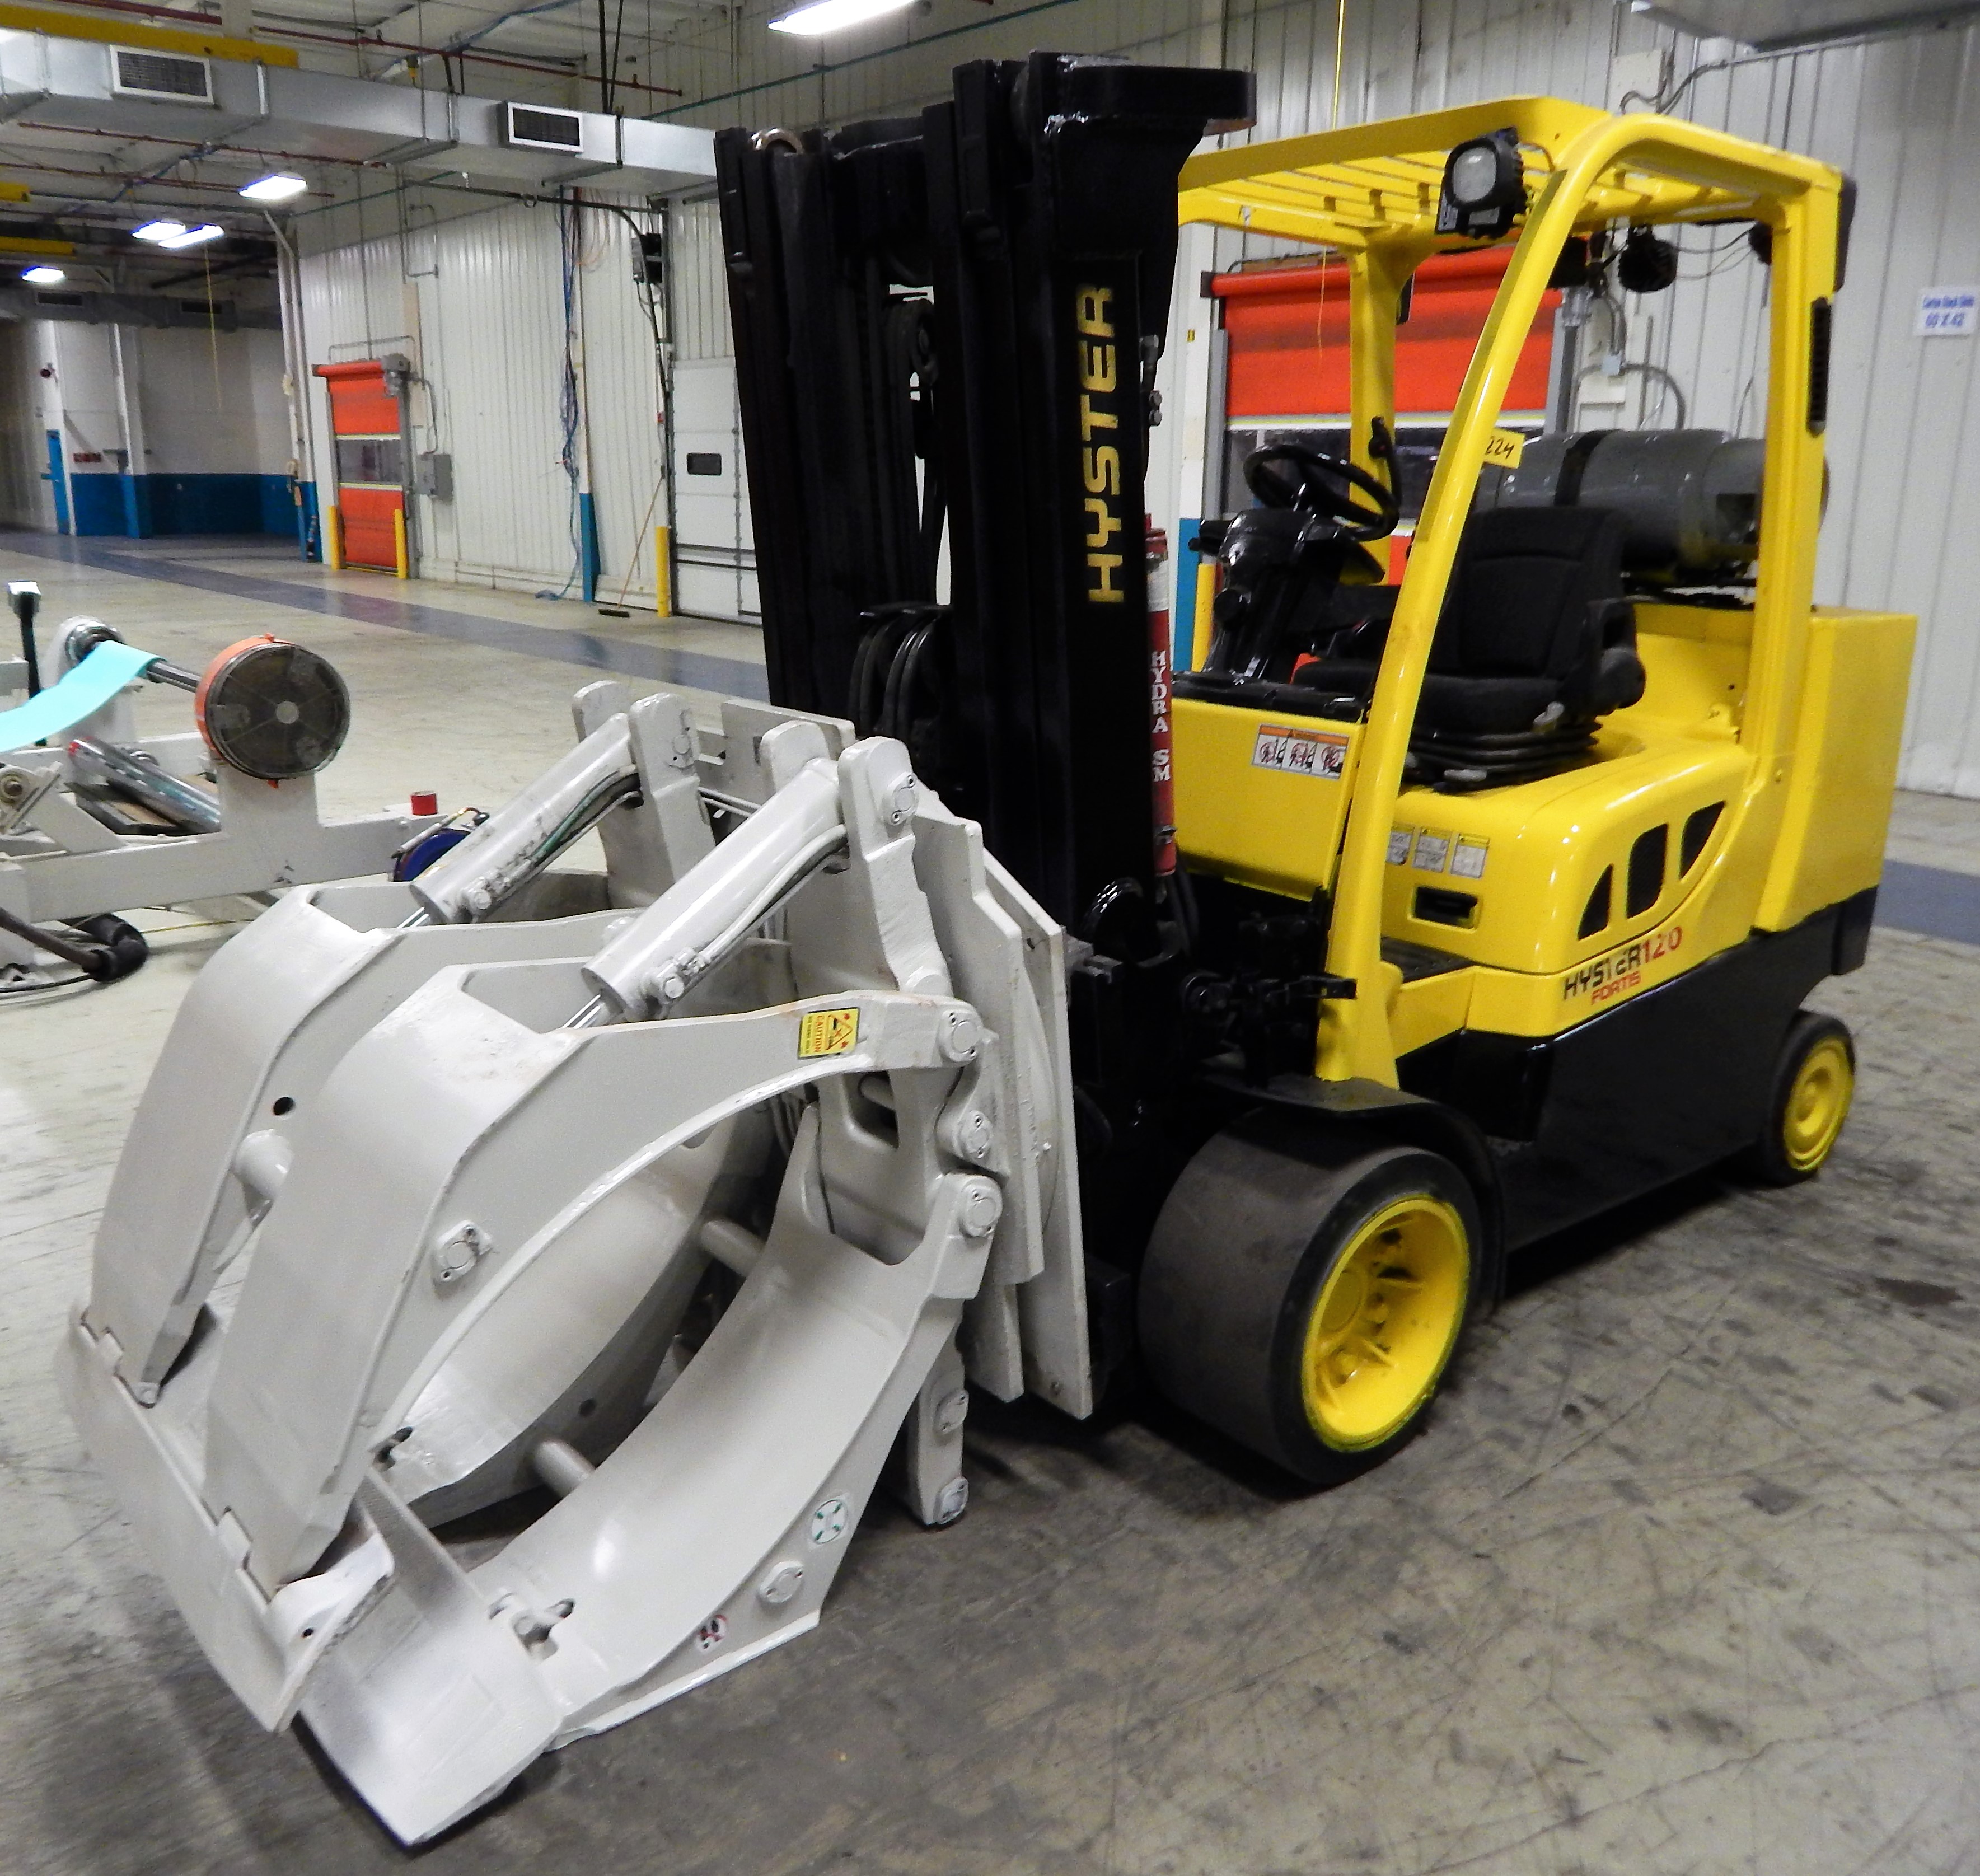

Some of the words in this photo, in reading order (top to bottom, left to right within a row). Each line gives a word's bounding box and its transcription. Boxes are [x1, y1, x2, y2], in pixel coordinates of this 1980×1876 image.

[1076, 283, 1124, 603] HYSTER
[1151, 649, 1169, 734] HYDRA
[1152, 748, 1171, 782] SM
[1564, 944, 1641, 1000] HYSTER
[1642, 926, 1683, 963] 120
[1590, 971, 1641, 1005] FORTIS
[815, 1015, 825, 1052] CAUTION
